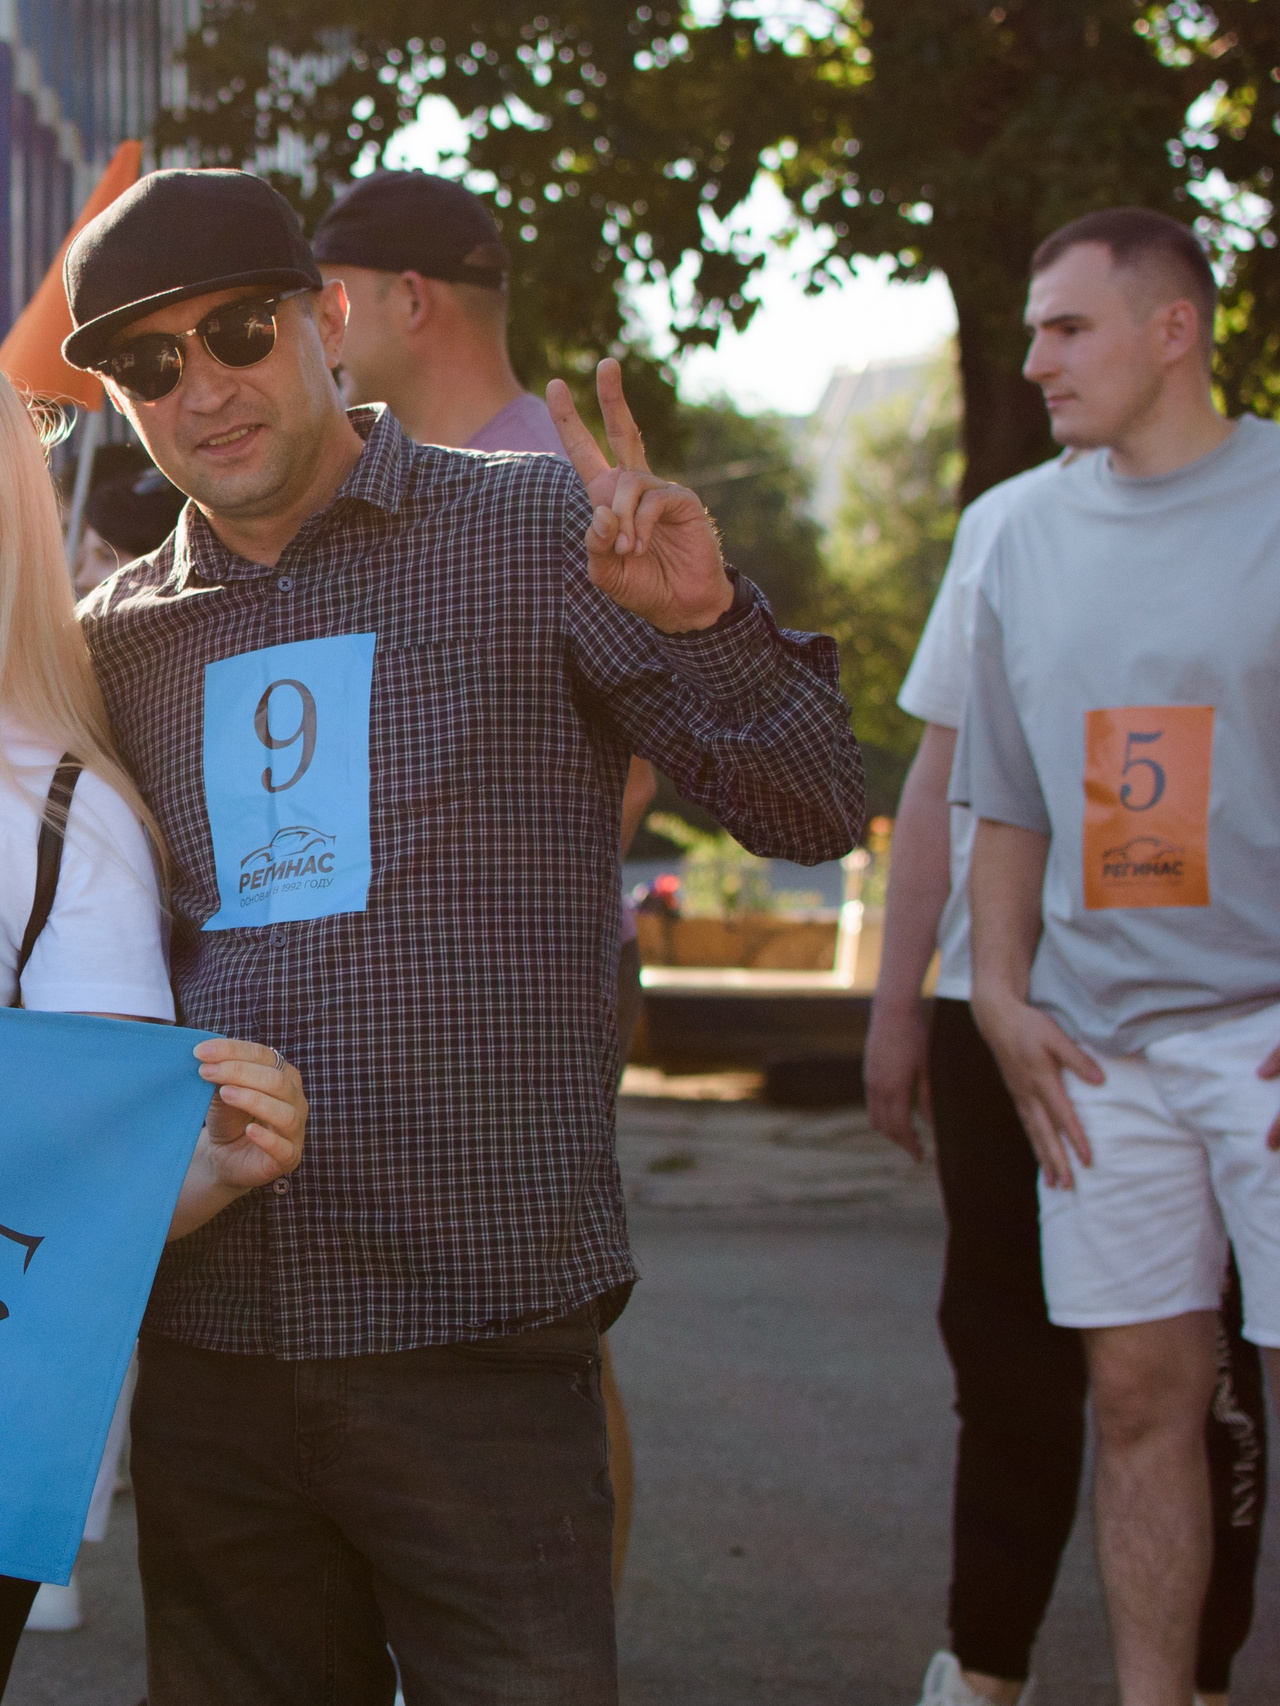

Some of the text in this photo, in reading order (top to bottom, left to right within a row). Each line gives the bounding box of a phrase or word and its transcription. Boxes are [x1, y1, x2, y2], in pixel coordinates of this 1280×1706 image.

[253, 678, 317, 793] 9
[1120, 730, 1167, 813] 5
[239, 852, 336, 894] РЕГИНАС
[281, 881, 302, 893] 1992
[303, 878, 335, 890] ГОДУ
